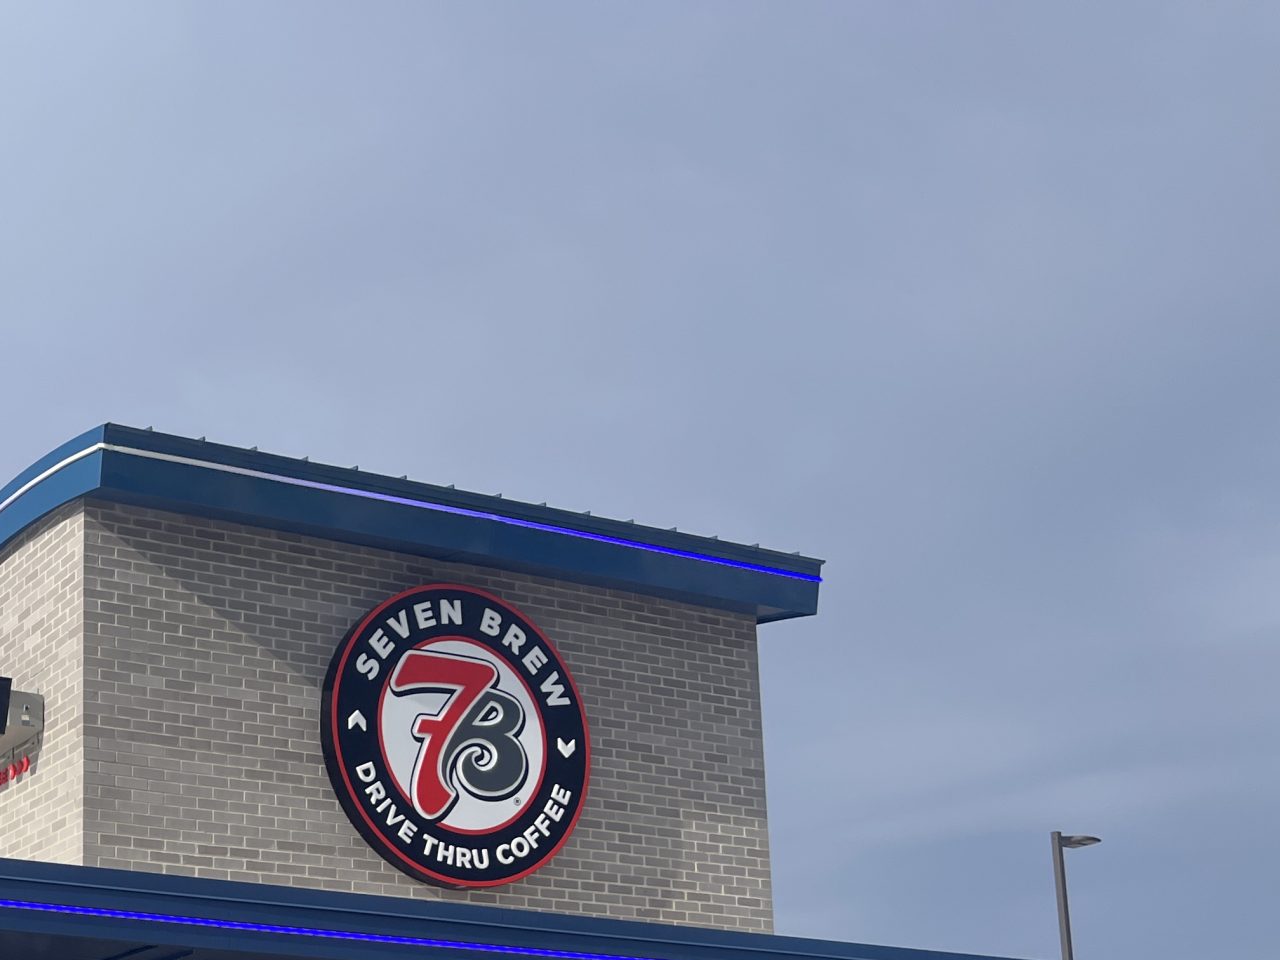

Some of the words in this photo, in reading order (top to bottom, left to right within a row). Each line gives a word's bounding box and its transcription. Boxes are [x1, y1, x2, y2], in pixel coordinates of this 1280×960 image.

[356, 599, 463, 681] SEVEN
[480, 607, 571, 707] BREW
[355, 760, 418, 844] DRIVE
[422, 833, 490, 870] THRU
[495, 783, 572, 866] COFFEE
